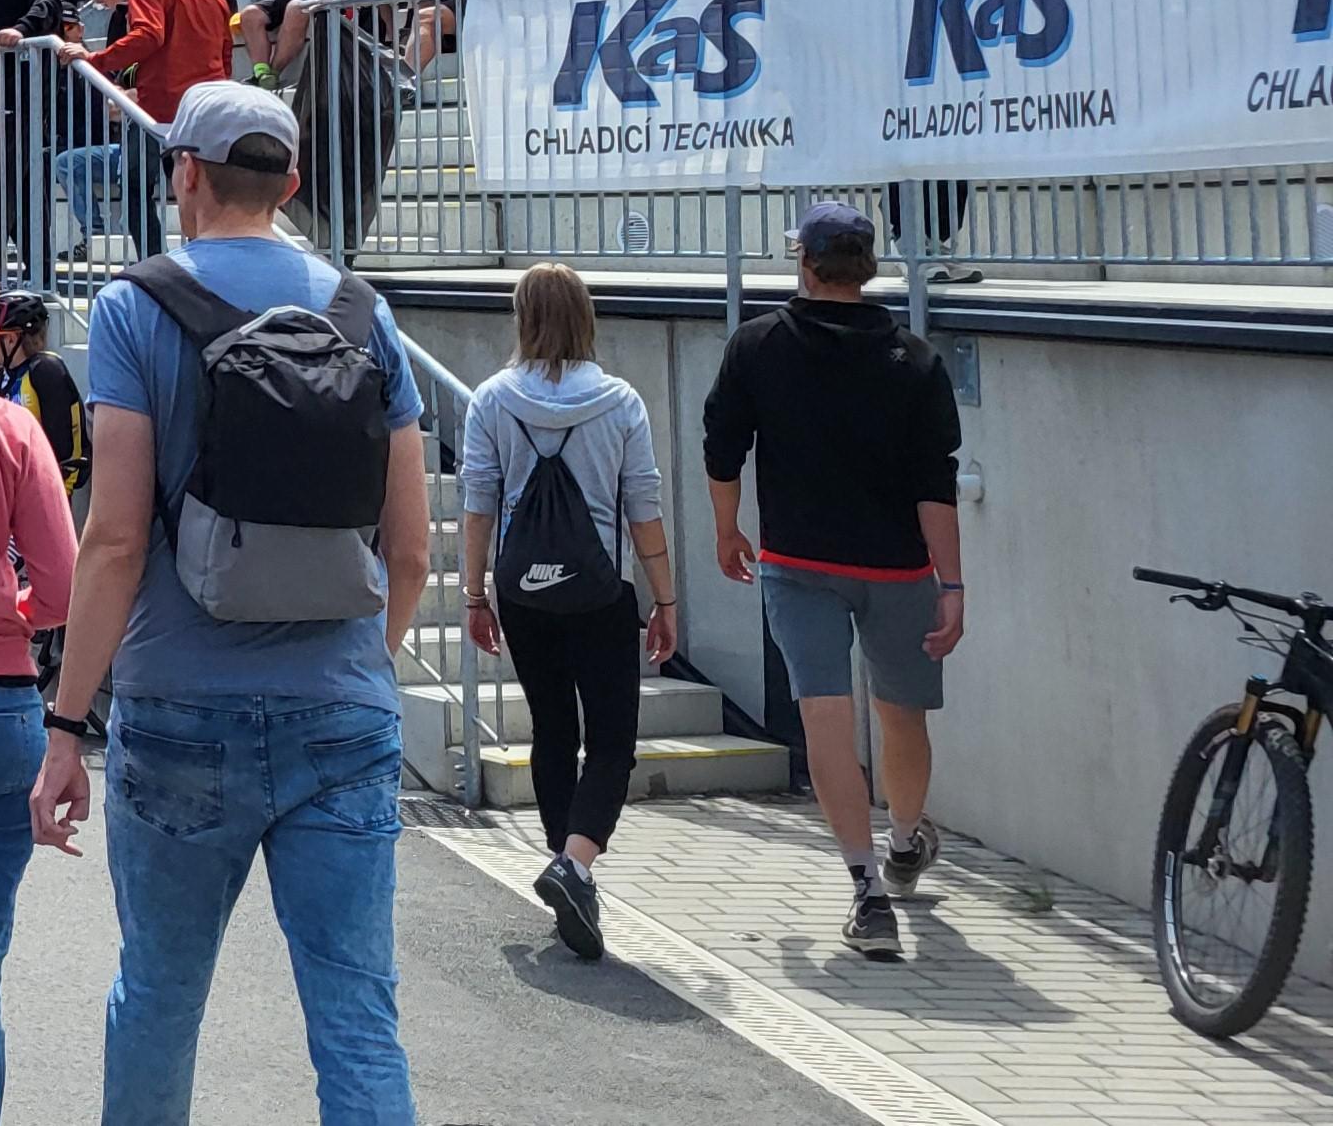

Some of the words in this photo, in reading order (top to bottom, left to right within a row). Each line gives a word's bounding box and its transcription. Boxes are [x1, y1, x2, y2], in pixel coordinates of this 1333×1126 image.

[1247, 65, 1333, 113] CHLA
[525, 117, 651, 156] CHLADICÍ
[659, 116, 795, 152] TECHNIKA
[882, 91, 984, 141] CHLADICÍ
[990, 88, 1116, 134] TECHNIKA
[527, 563, 564, 580] NIKE
